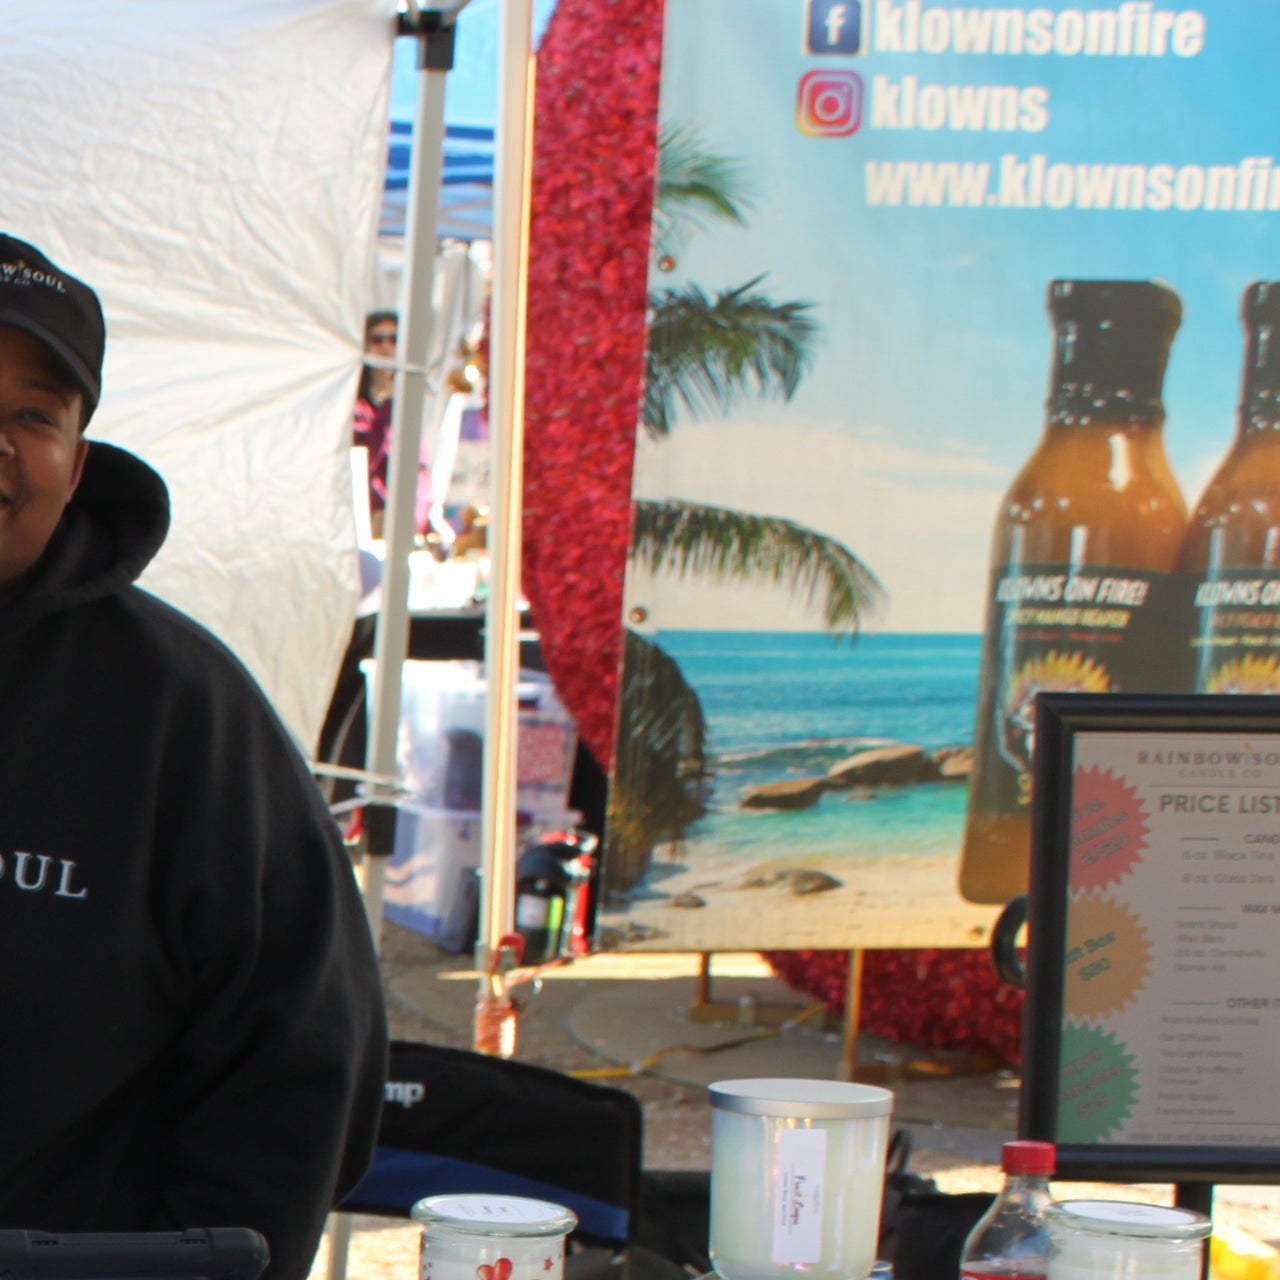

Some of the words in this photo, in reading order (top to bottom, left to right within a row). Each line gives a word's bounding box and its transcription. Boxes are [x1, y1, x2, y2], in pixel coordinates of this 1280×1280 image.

[875, 0, 1206, 57] klownsonfire
[871, 75, 1049, 131] klowns
[23, 267, 67, 293] SOUL
[1064, 576, 1099, 603] ON
[1137, 751, 1243, 767] RAINBOW
[1178, 768, 1236, 779] CANDLE
[1159, 794, 1230, 814] PRICE
